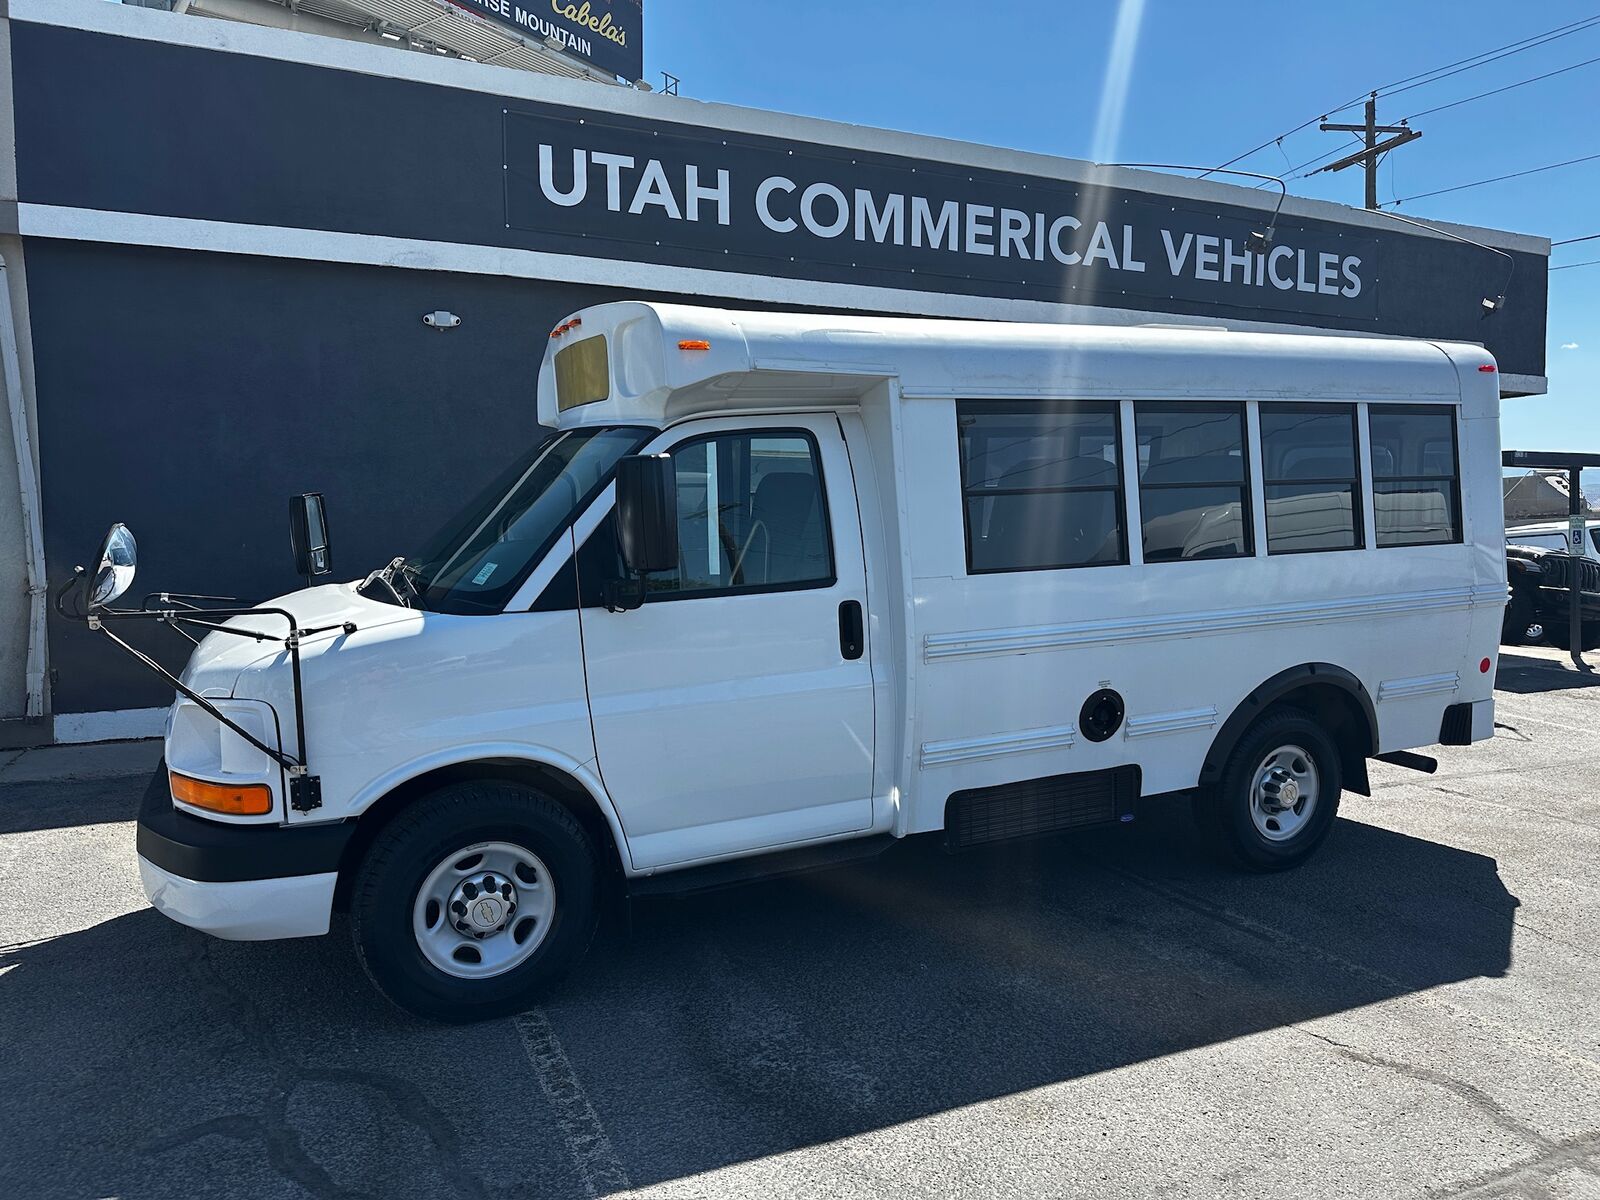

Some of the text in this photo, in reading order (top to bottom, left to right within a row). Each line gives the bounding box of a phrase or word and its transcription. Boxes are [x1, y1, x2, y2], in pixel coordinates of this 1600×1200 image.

[515, 6, 591, 57] MOUNTAIN
[538, 143, 1362, 298] UTAH COMMERICAL VEHICLES
